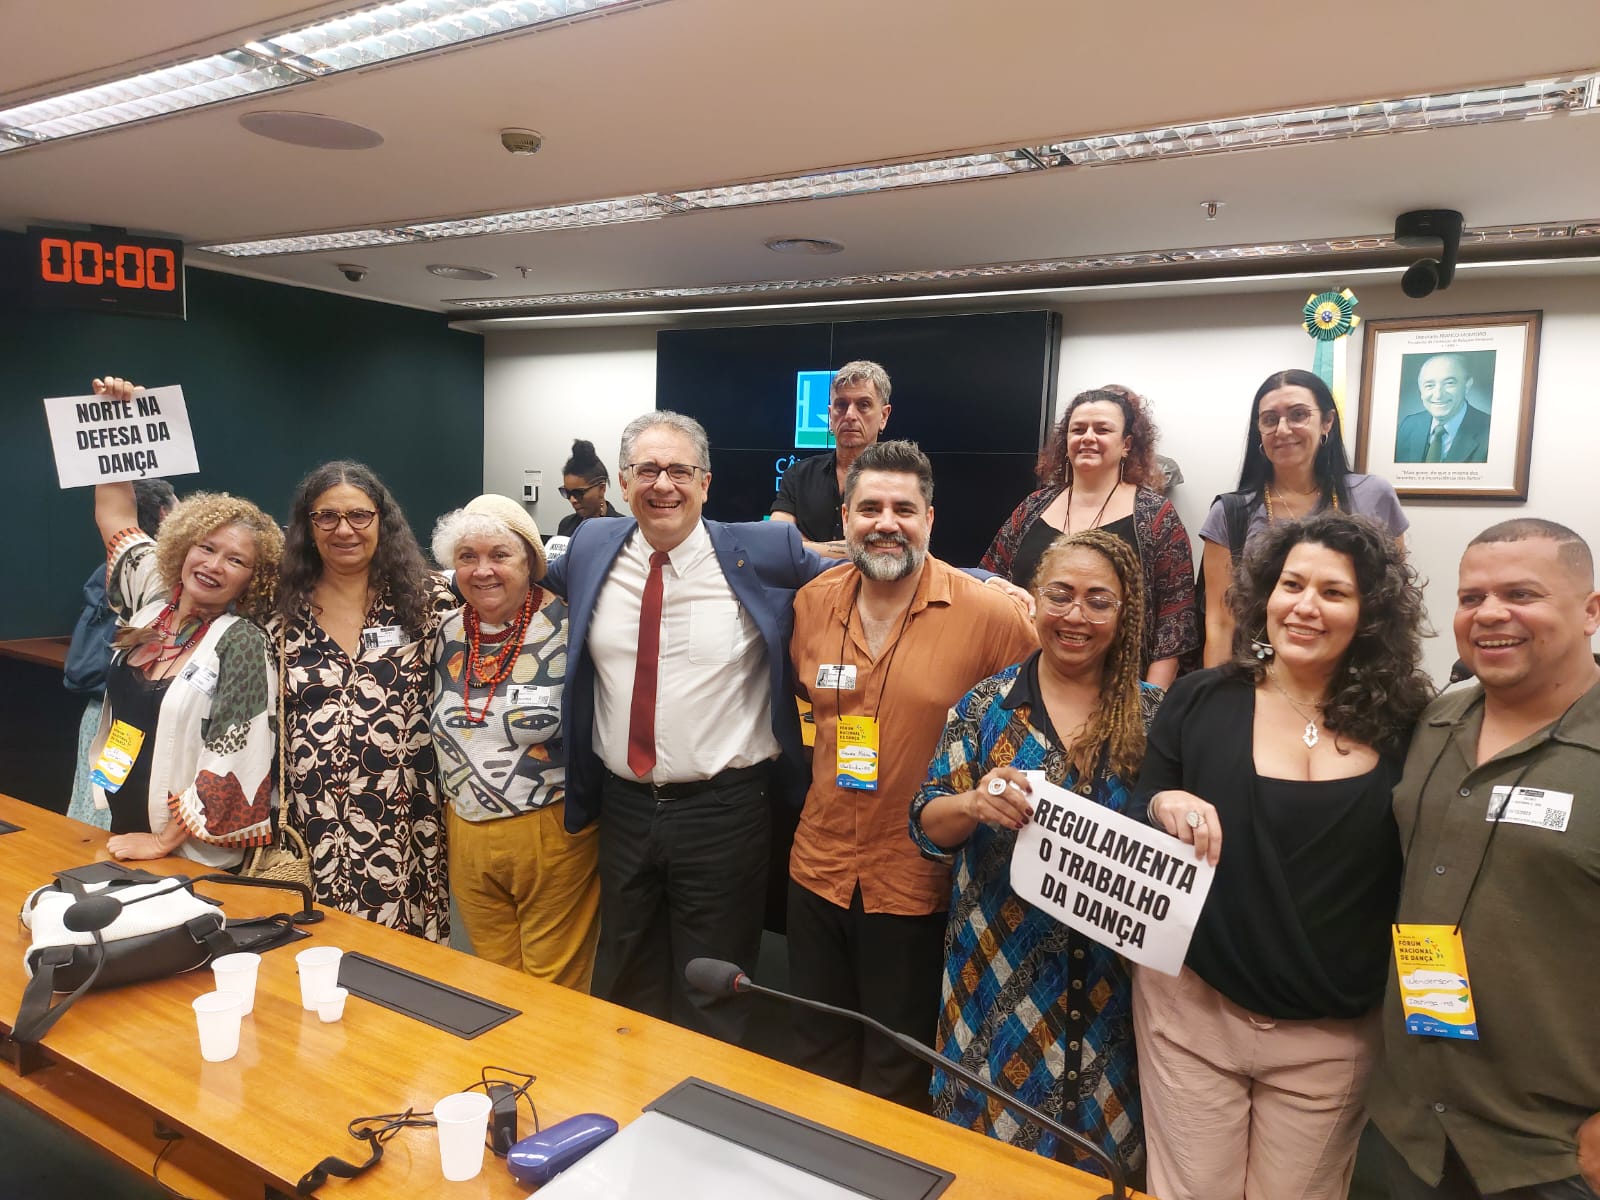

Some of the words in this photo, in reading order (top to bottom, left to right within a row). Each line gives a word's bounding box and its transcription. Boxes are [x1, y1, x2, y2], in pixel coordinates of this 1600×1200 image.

[41, 238, 175, 291] 00:00
[76, 399, 133, 424] NORTE
[137, 395, 162, 417] NA
[76, 424, 142, 451] DEFESA
[147, 421, 170, 443] DA
[98, 449, 159, 477] DANÇA
[1034, 798, 1198, 894] REGULAMENTA
[1039, 837, 1053, 862] O
[1058, 847, 1171, 921] TRABALHO
[1040, 873, 1067, 908] DA
[1072, 892, 1147, 950] DANÇA
